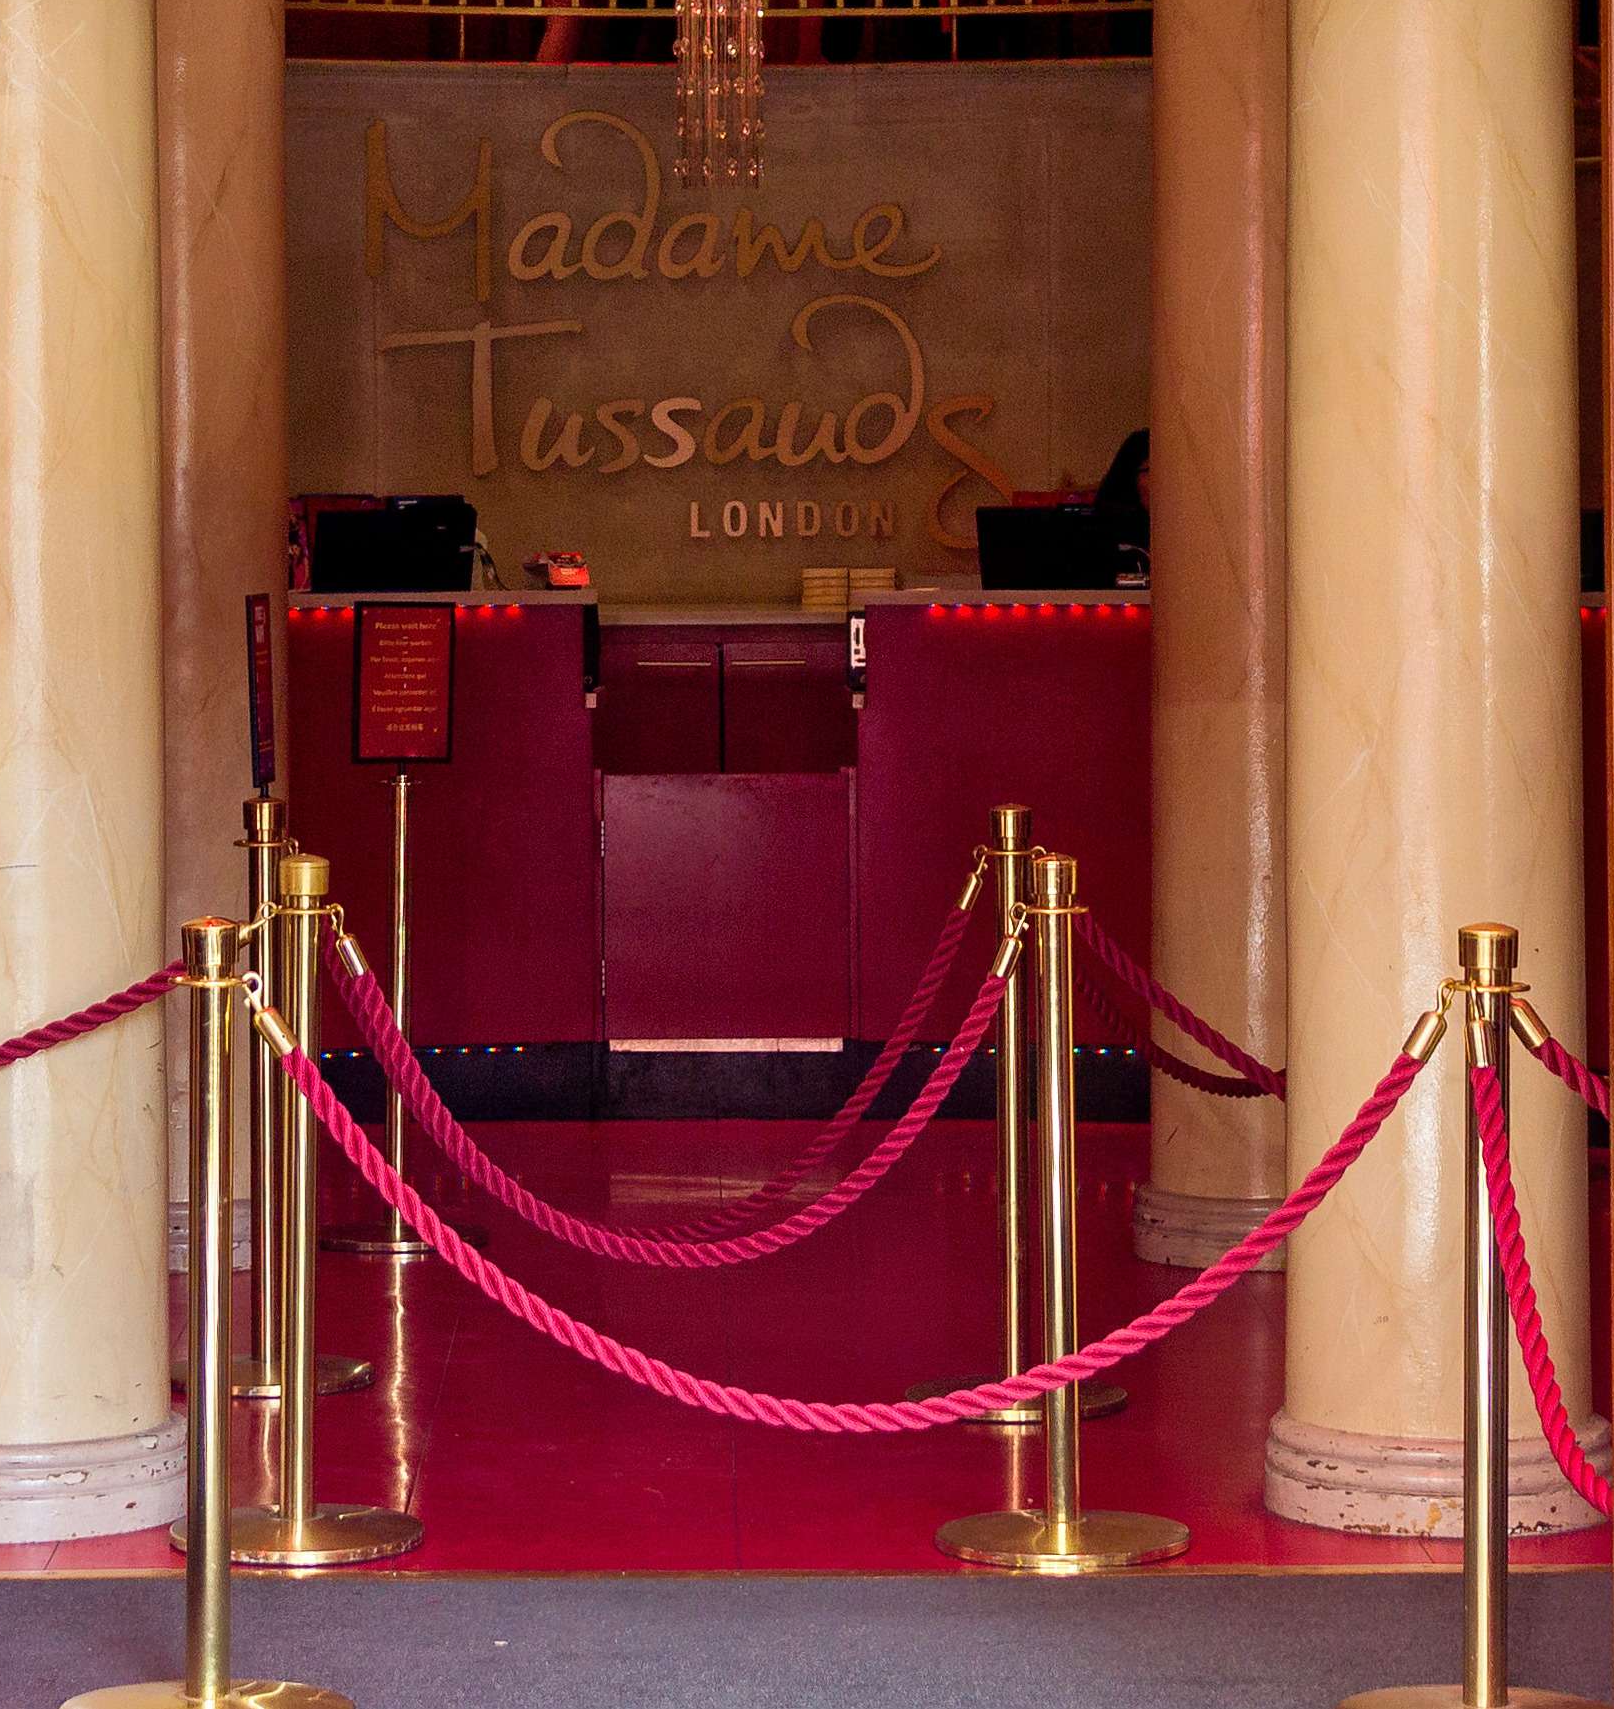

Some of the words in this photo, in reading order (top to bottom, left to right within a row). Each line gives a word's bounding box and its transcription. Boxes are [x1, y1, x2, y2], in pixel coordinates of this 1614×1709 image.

[364, 111, 942, 302] Madame
[380, 293, 1014, 550] Tussauds
[689, 500, 897, 539] LONDON
